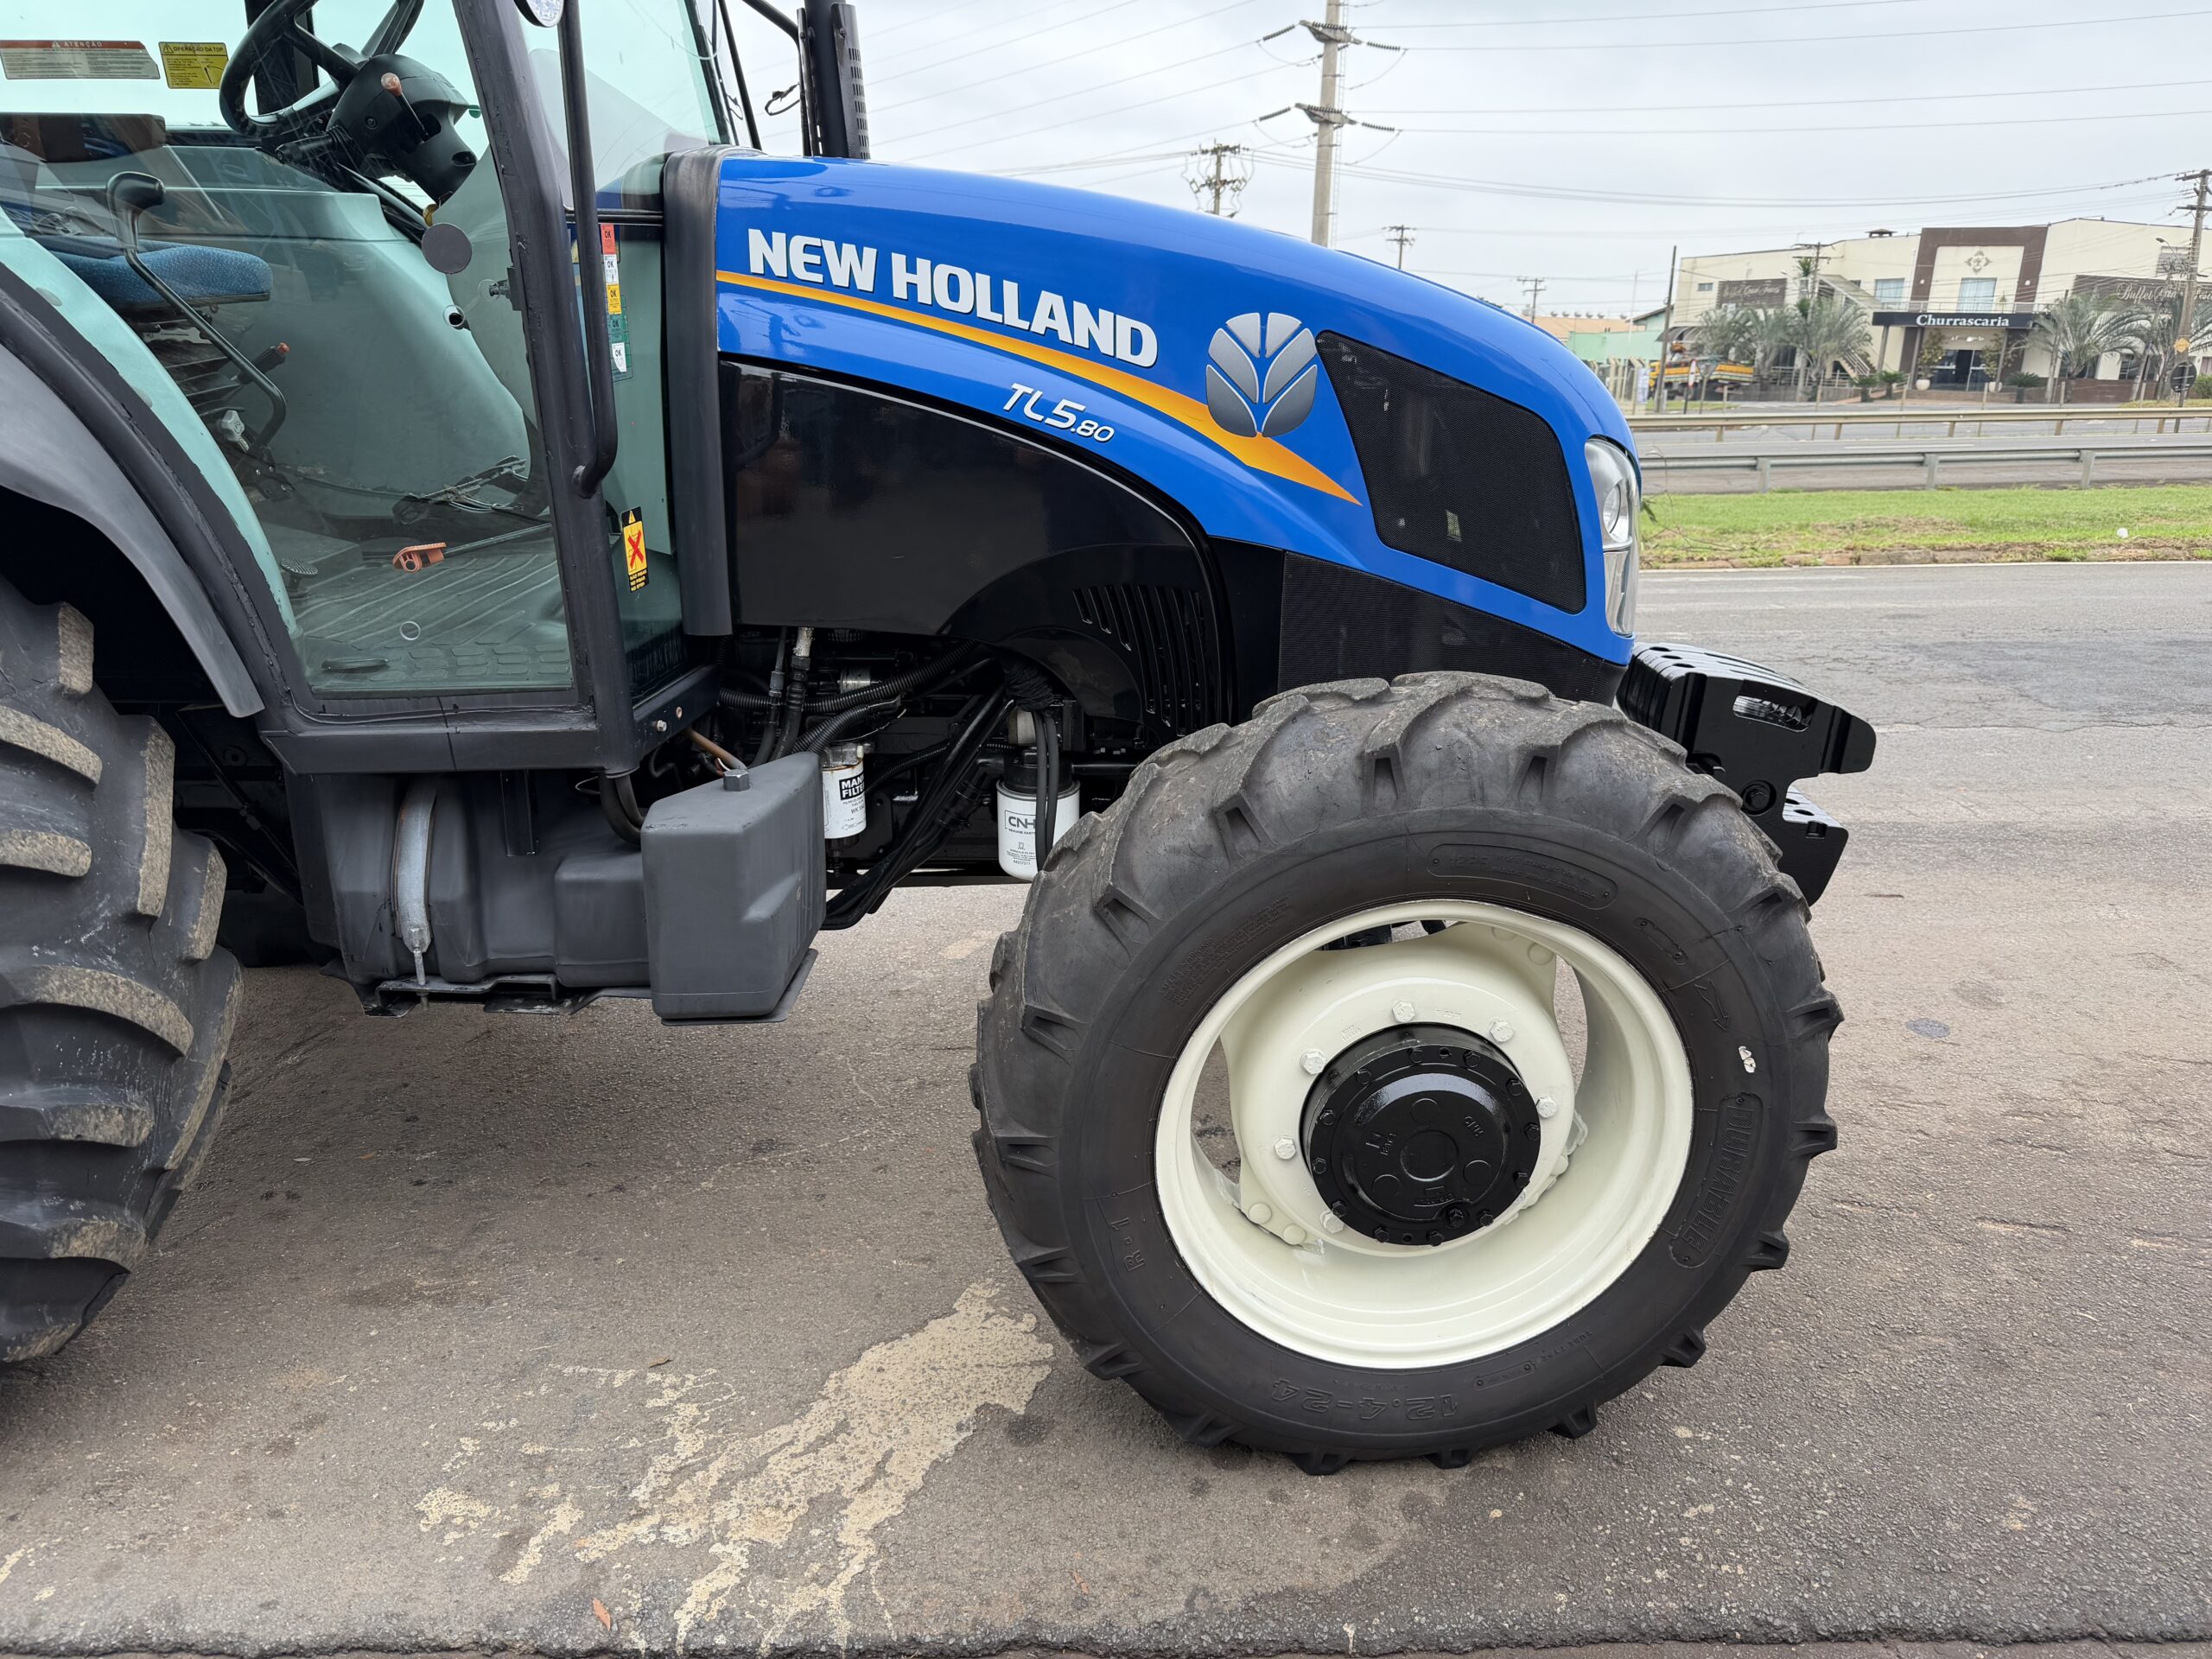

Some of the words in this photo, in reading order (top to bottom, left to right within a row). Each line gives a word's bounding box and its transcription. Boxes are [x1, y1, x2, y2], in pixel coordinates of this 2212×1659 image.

[605, 230, 612, 238] OK
[607, 260, 614, 269] OK
[610, 289, 617, 298] OK
[748, 228, 877, 292] NEW
[891, 251, 1158, 368] HOLLAND
[1916, 314, 2010, 327] Churrascaria
[1003, 383, 1115, 442] TL5.80
[842, 782, 864, 798] FILTE
[1008, 816, 1035, 830] CNH
[1682, 1105, 1755, 1253] DURABLE
[1271, 1377, 1459, 1421] 12.4-24
